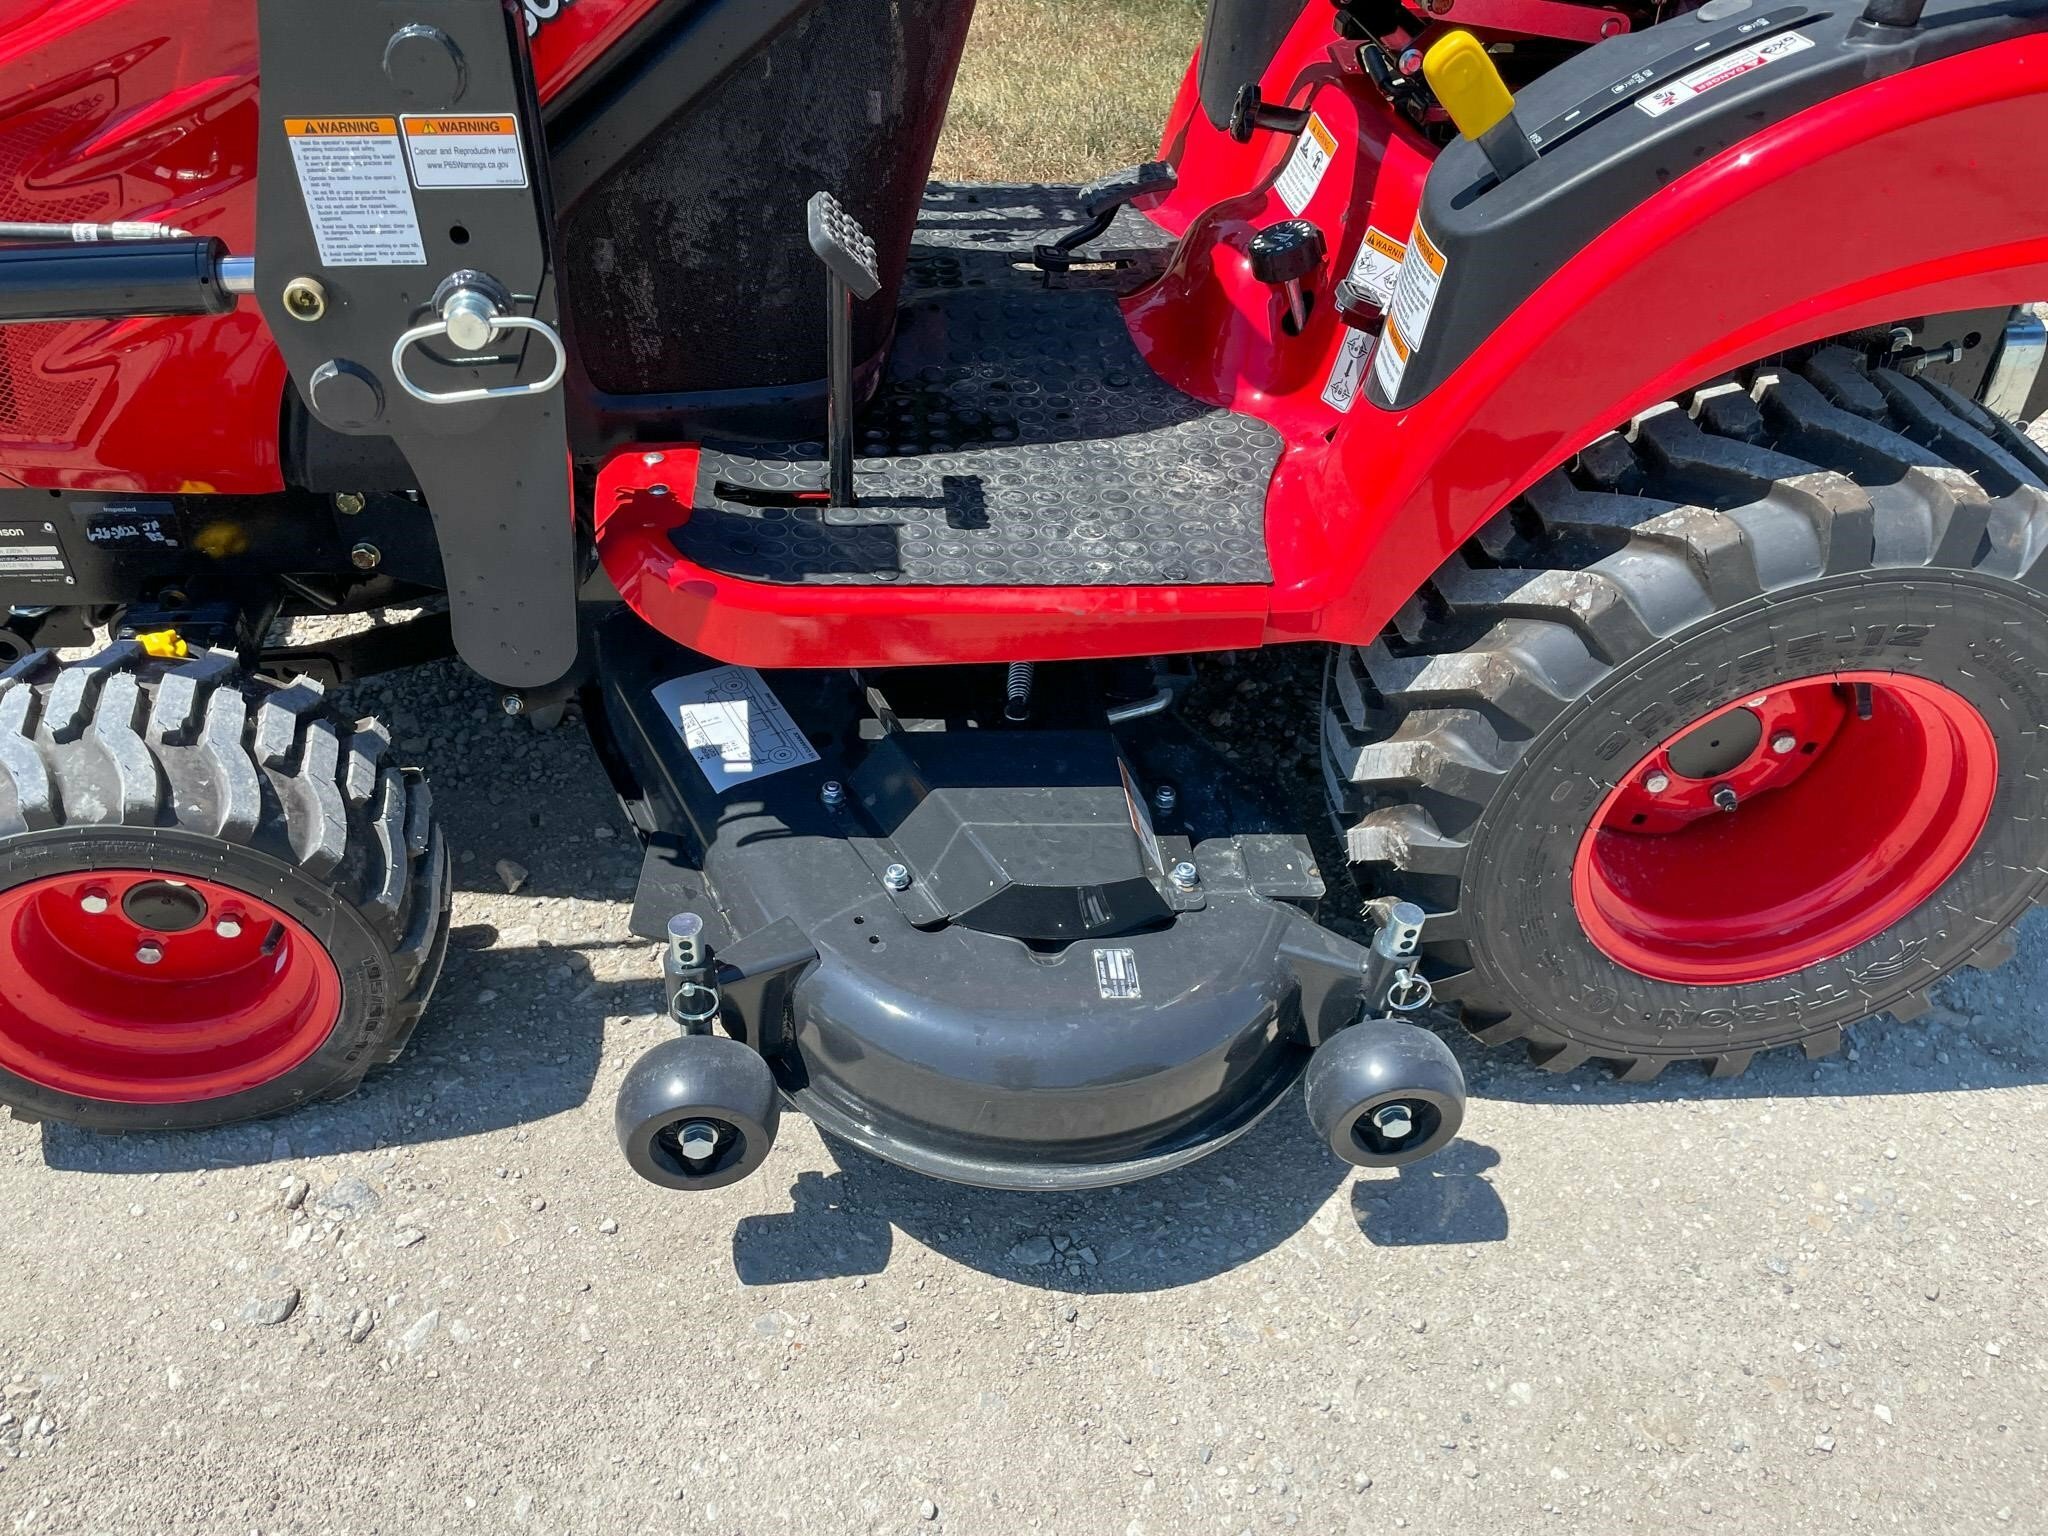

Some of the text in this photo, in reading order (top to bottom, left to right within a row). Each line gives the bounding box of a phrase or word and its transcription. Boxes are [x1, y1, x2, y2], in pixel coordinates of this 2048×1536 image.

[1697, 66, 1747, 90] DANGER
[317, 121, 380, 133] WARNING
[438, 121, 500, 133] WARNING
[414, 147, 438, 156] Cancer
[454, 146, 496, 156] Reproductive
[498, 146, 516, 154] Harm
[427, 160, 509, 171] www.P65Warnings.ca.gov
[1376, 240, 1405, 260] WARNIN
